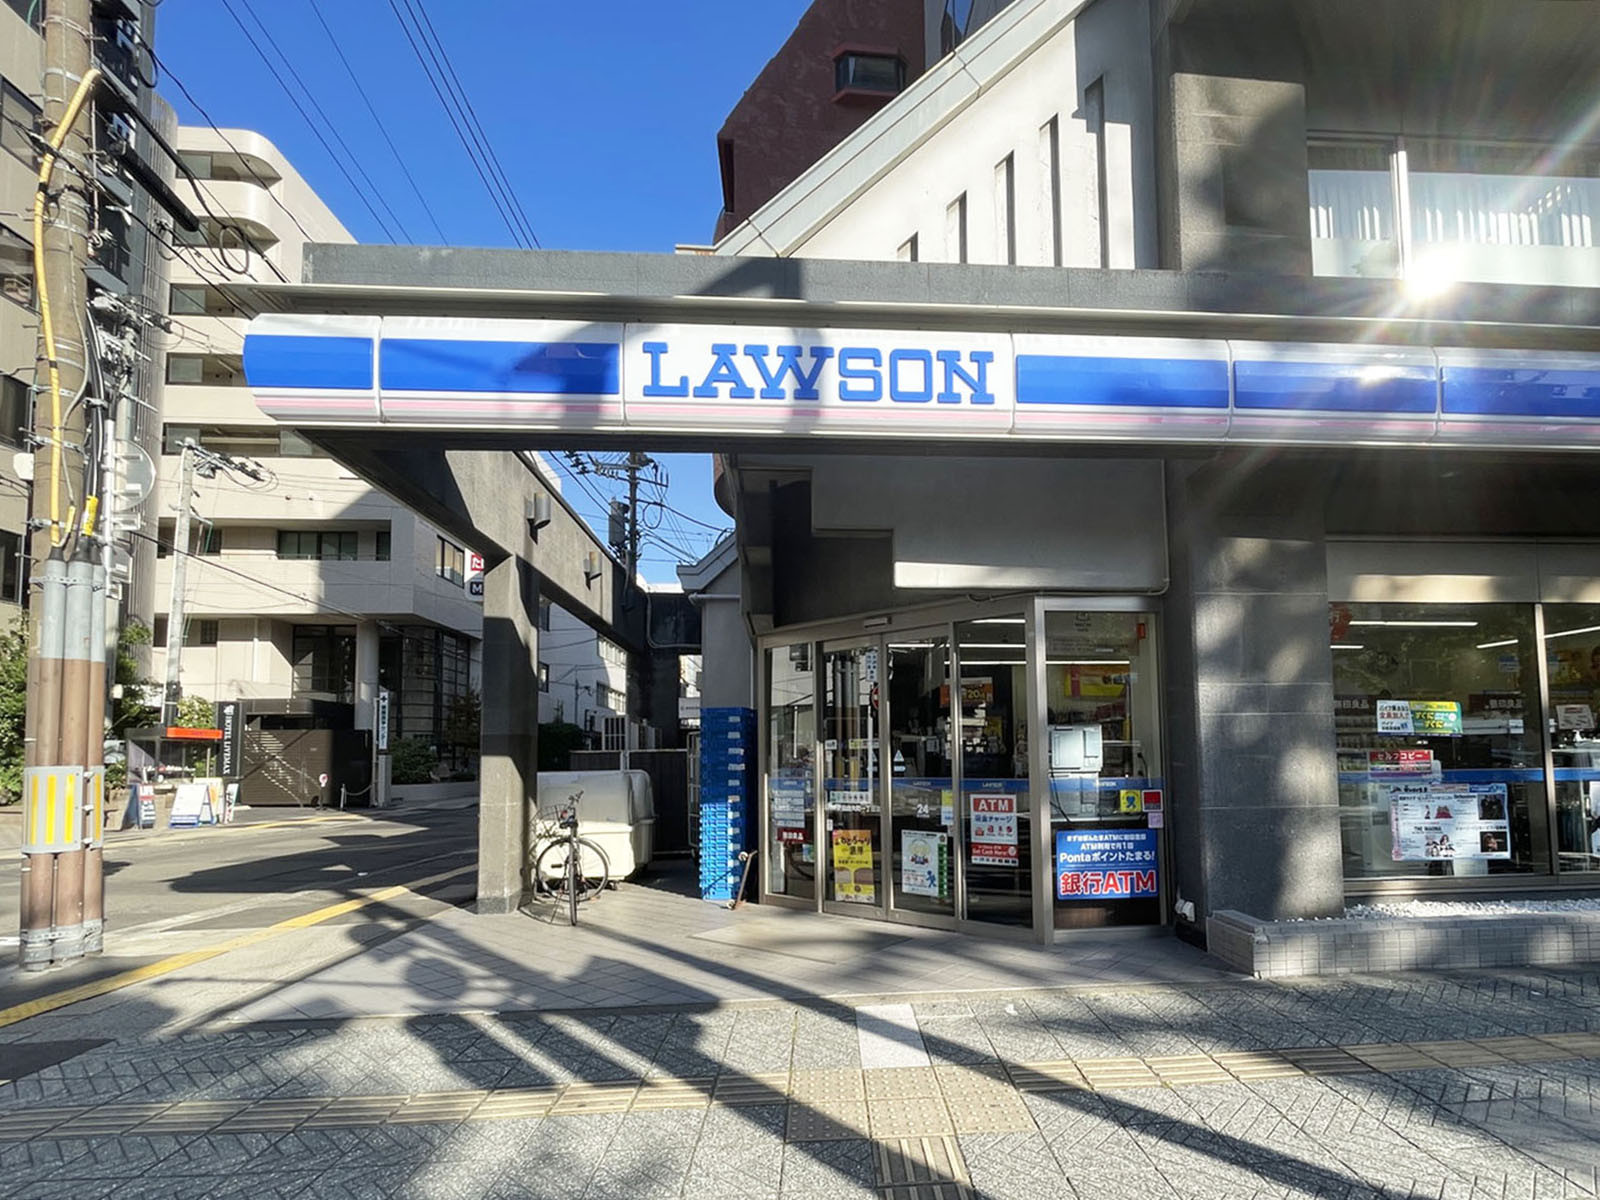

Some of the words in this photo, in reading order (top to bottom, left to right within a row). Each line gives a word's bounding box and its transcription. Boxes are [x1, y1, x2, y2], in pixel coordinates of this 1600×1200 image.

[642, 341, 995, 404] LAWSON
[1377, 751, 1423, 761] セルフコピー
[916, 803, 929, 815] 24
[978, 799, 1009, 811] ATM
[1059, 851, 1155, 863] Pontaポイントたまる!
[1060, 871, 1157, 895] 銀行ATM
